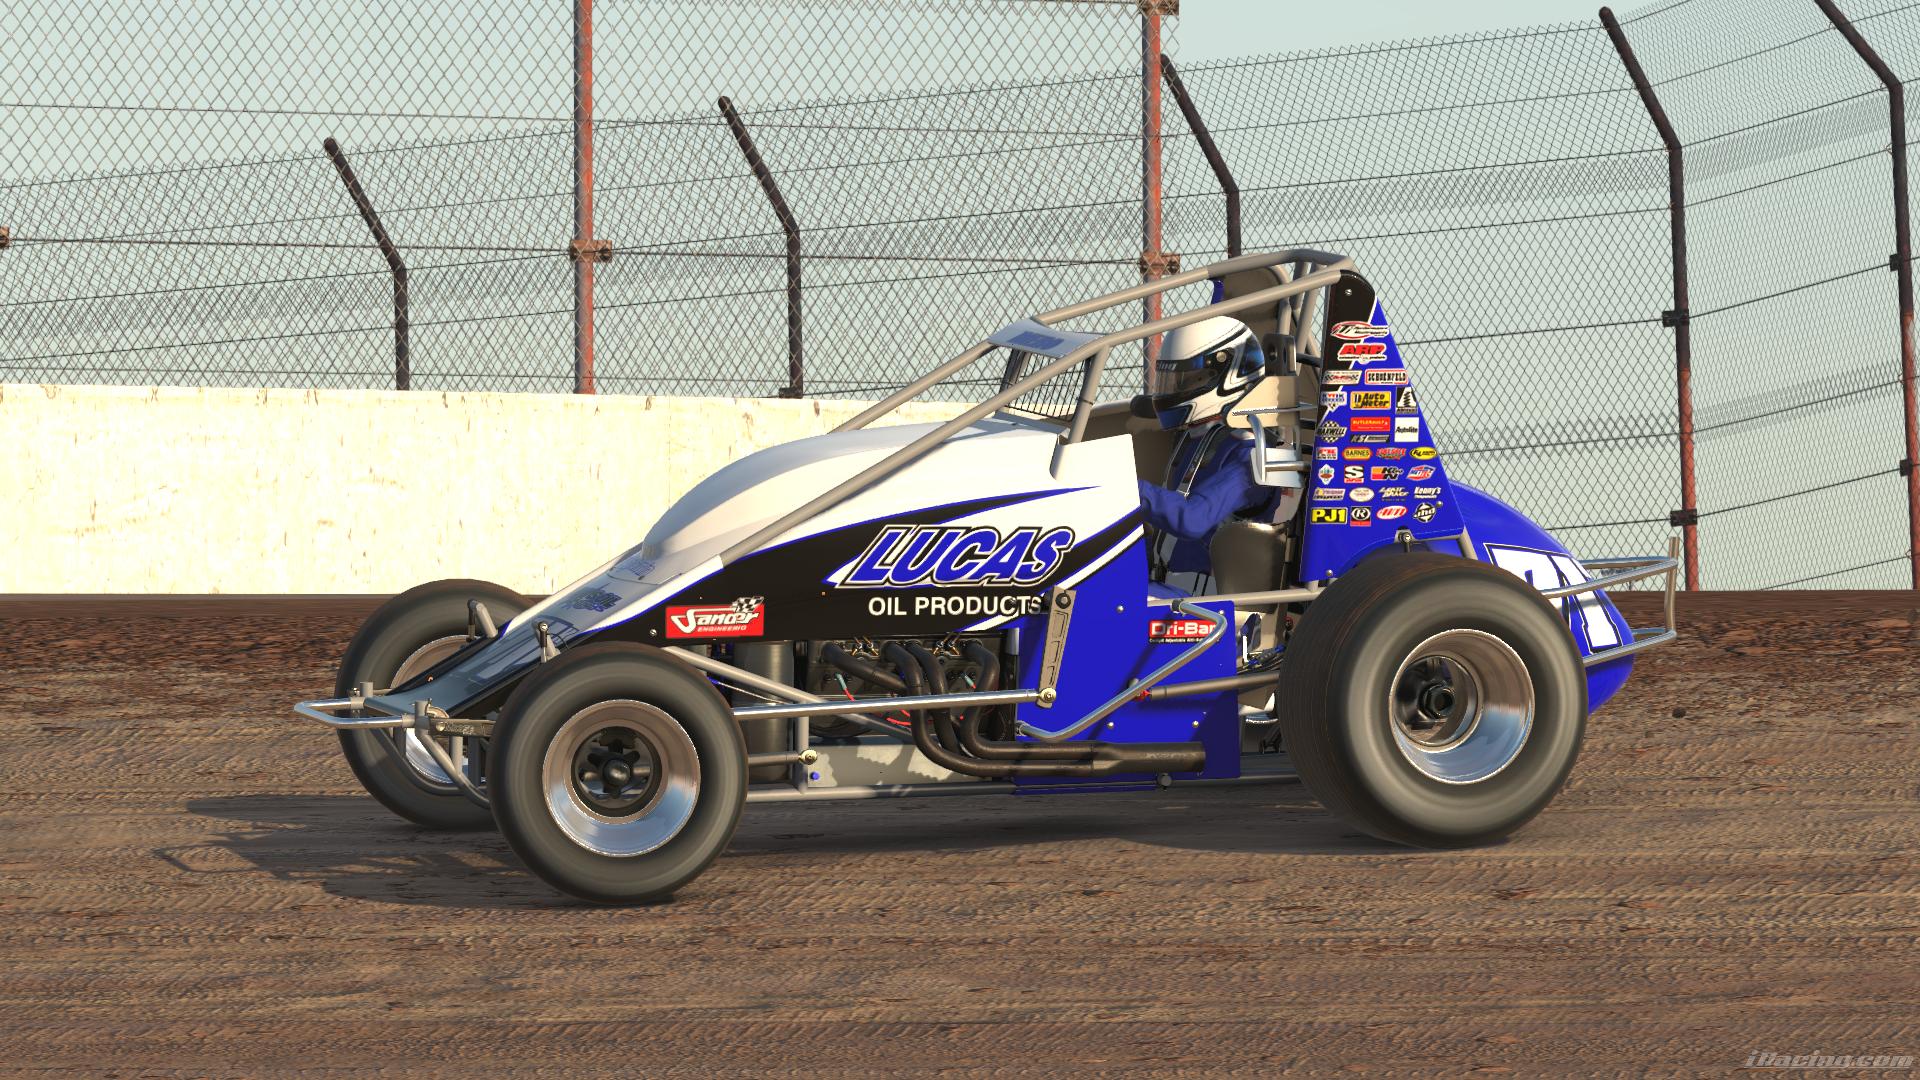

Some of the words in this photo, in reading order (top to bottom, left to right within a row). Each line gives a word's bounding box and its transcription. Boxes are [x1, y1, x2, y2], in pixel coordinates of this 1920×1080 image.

[1339, 344, 1385, 355] ARP
[1368, 373, 1406, 381] SCHOENFELD
[1345, 466, 1363, 478] S
[1312, 509, 1346, 522] PJ1
[836, 524, 1076, 588] LUCAS
[868, 596, 907, 616] OIL
[914, 595, 1042, 617] PRODUCTS
[670, 607, 760, 634] Sander
